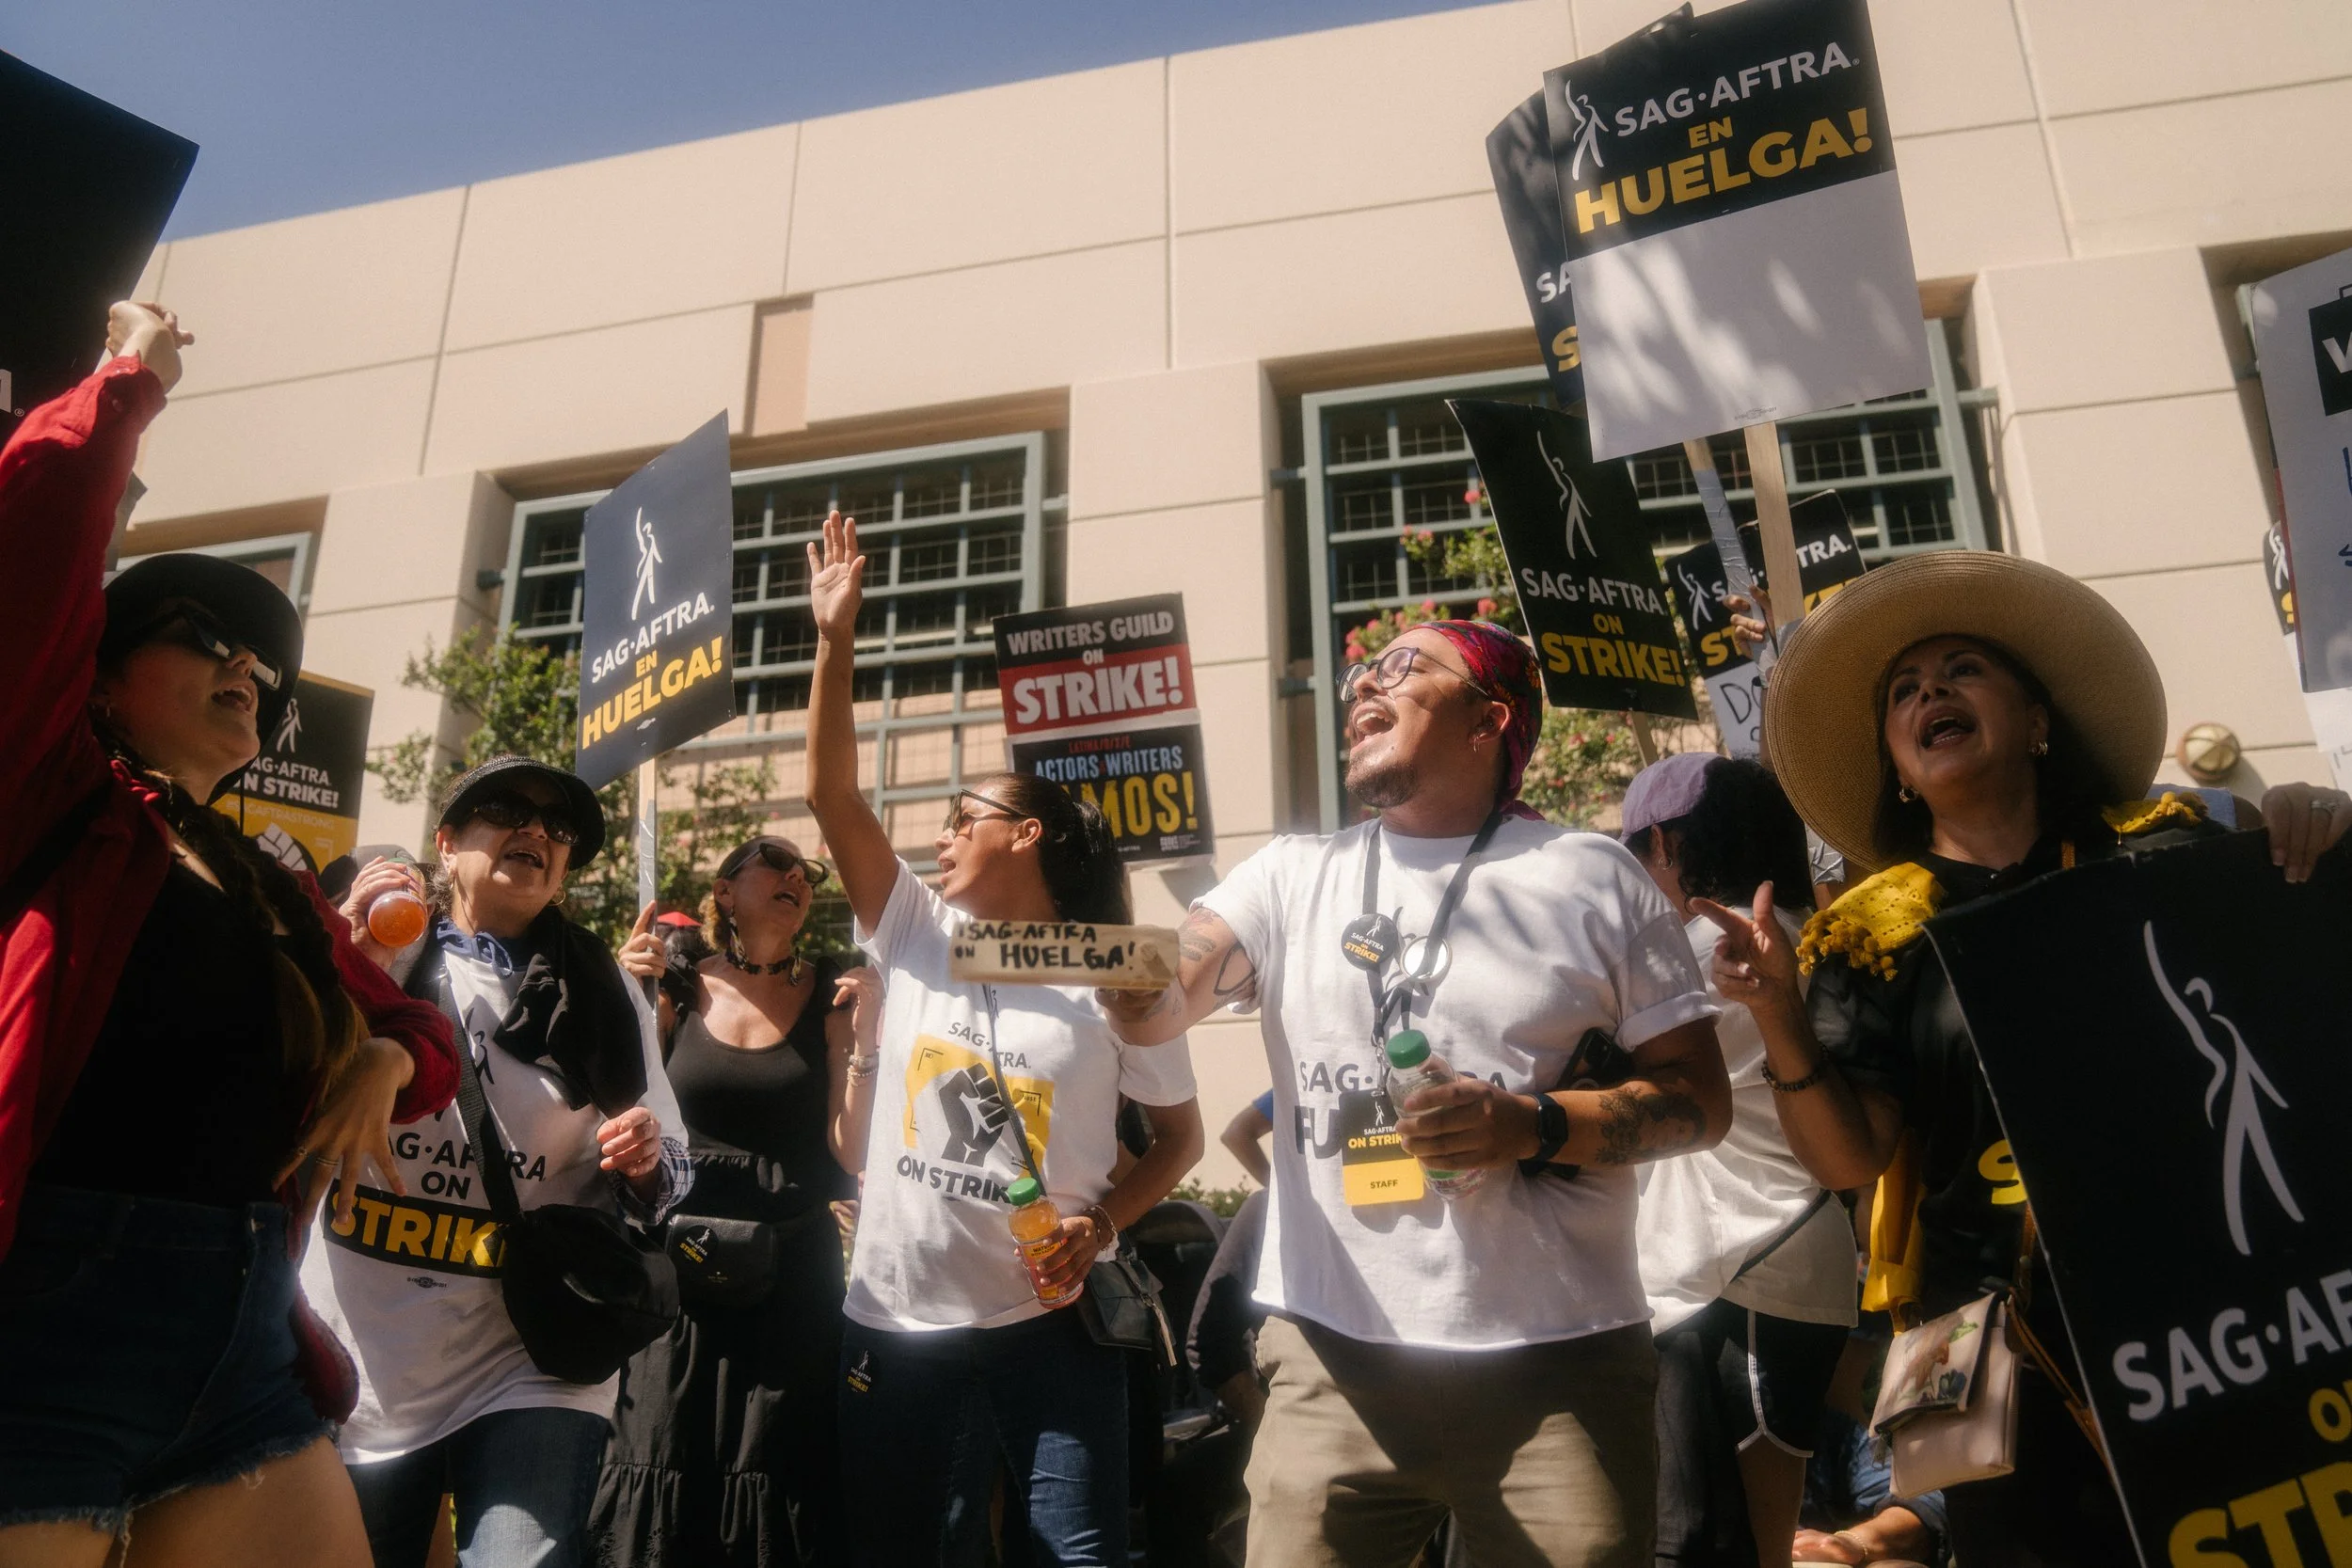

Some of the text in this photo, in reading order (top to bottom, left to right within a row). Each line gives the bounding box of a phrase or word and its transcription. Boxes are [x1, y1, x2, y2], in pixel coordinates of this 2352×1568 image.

[1688, 117, 1734, 149] EN
[1575, 107, 1872, 234] HUELGA!
[1007, 611, 1174, 657] WRITERS GUILD
[1593, 613, 1625, 635] ON
[636, 650, 658, 678] EN
[1083, 648, 1104, 666] ON
[1541, 632, 1686, 688] STRIKE!
[582, 636, 723, 750] HUELGA!
[1012, 656, 1184, 725] STRIKE!
[1036, 754, 1100, 782] ACTORS
[1104, 745, 1184, 777] WRITERS
[262, 776, 340, 810] STRIKE!
[1000, 941, 1136, 973] HUELGA!
[1343, 942, 1380, 963] STRIKE!
[1347, 1133, 1404, 1149] ON STRIK
[421, 1171, 470, 1200] ON
[897, 1154, 1012, 1205] ON STRIK
[1370, 1179, 1399, 1190] STAFF
